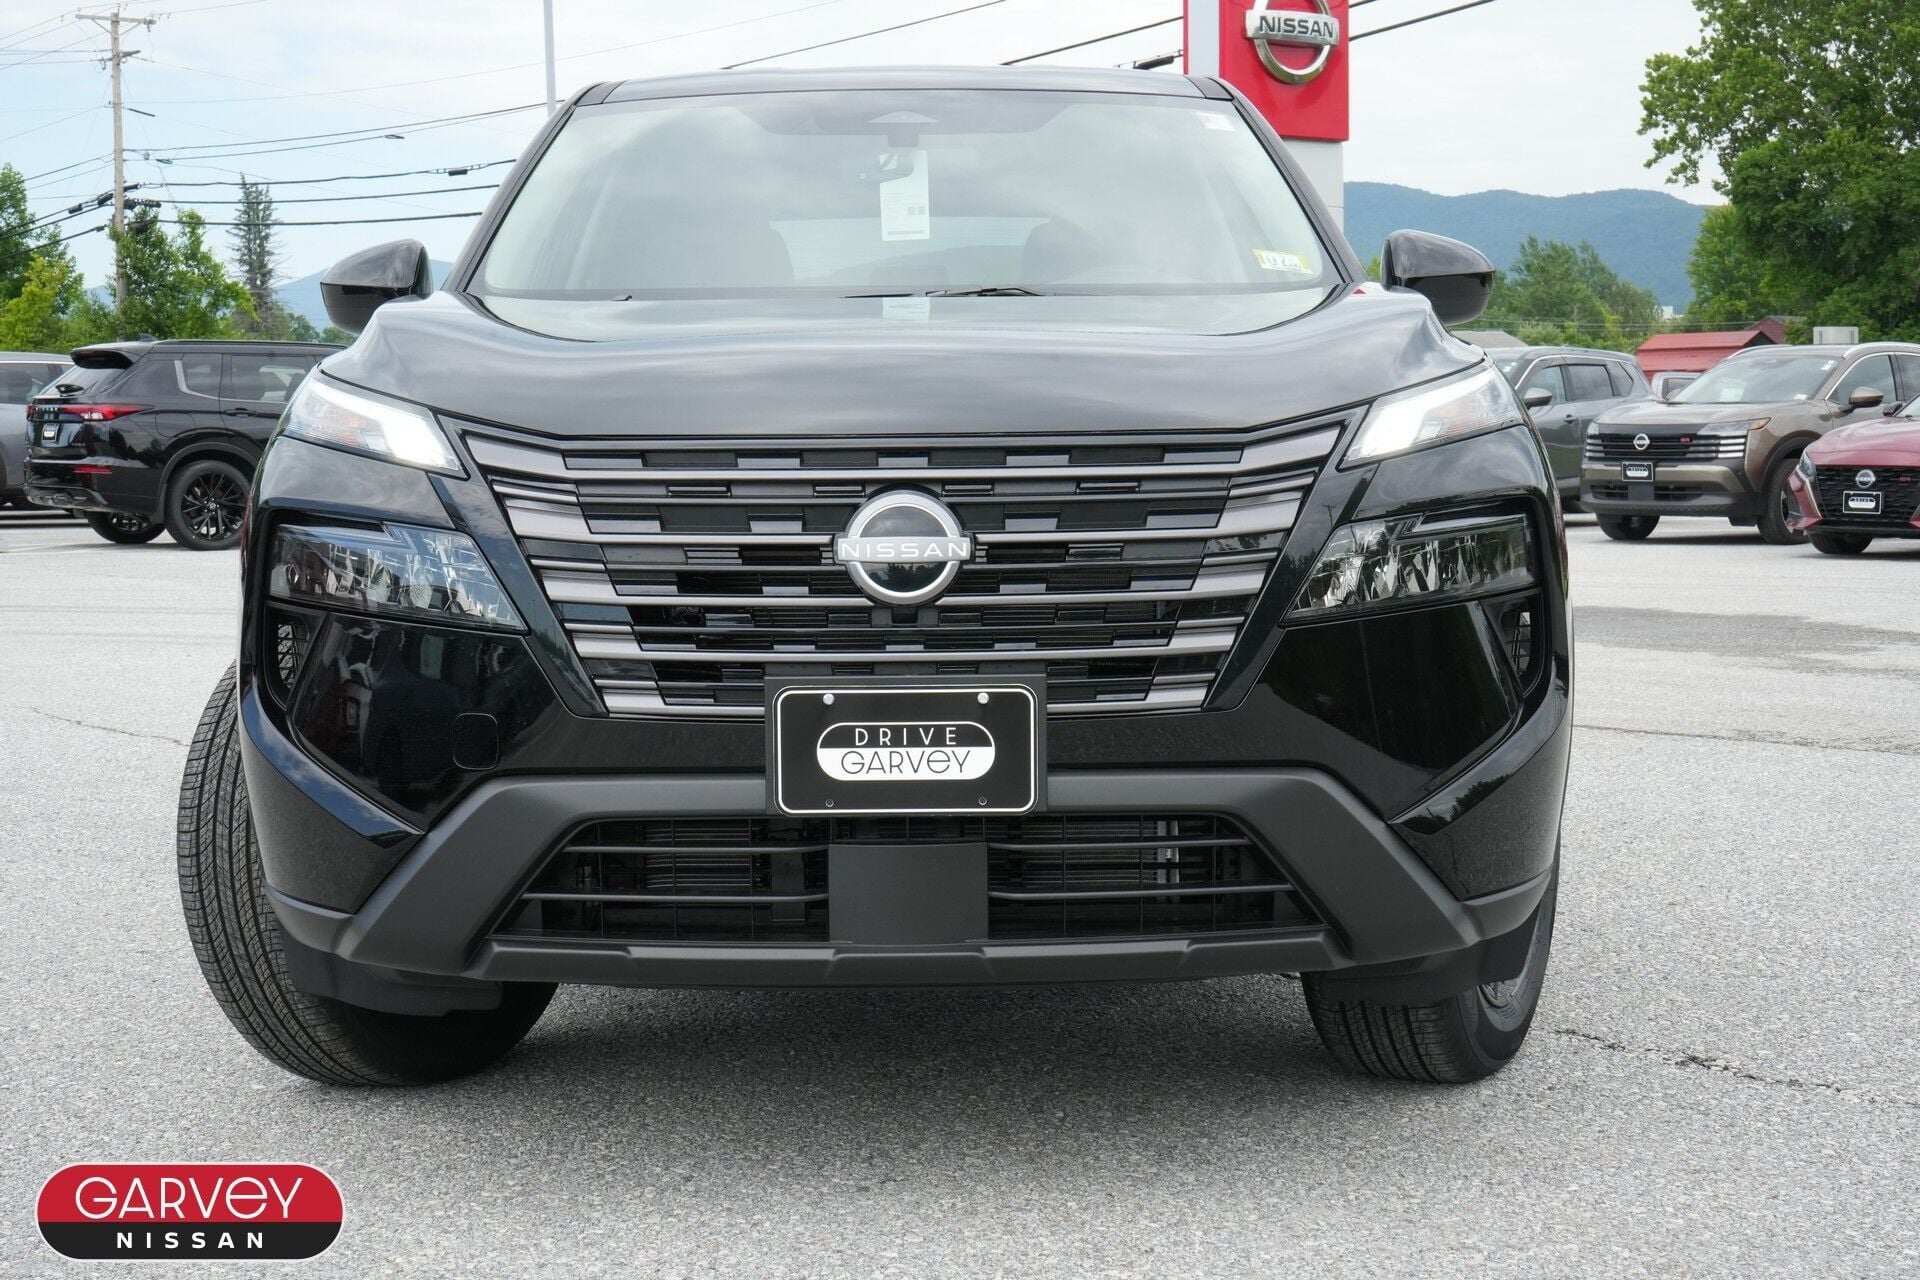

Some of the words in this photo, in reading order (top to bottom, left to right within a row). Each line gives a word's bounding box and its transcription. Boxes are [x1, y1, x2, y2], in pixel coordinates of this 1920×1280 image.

[1259, 16, 1333, 38] NISSAN
[841, 542, 967, 558] NISSAN
[855, 727, 957, 746] DRIVE
